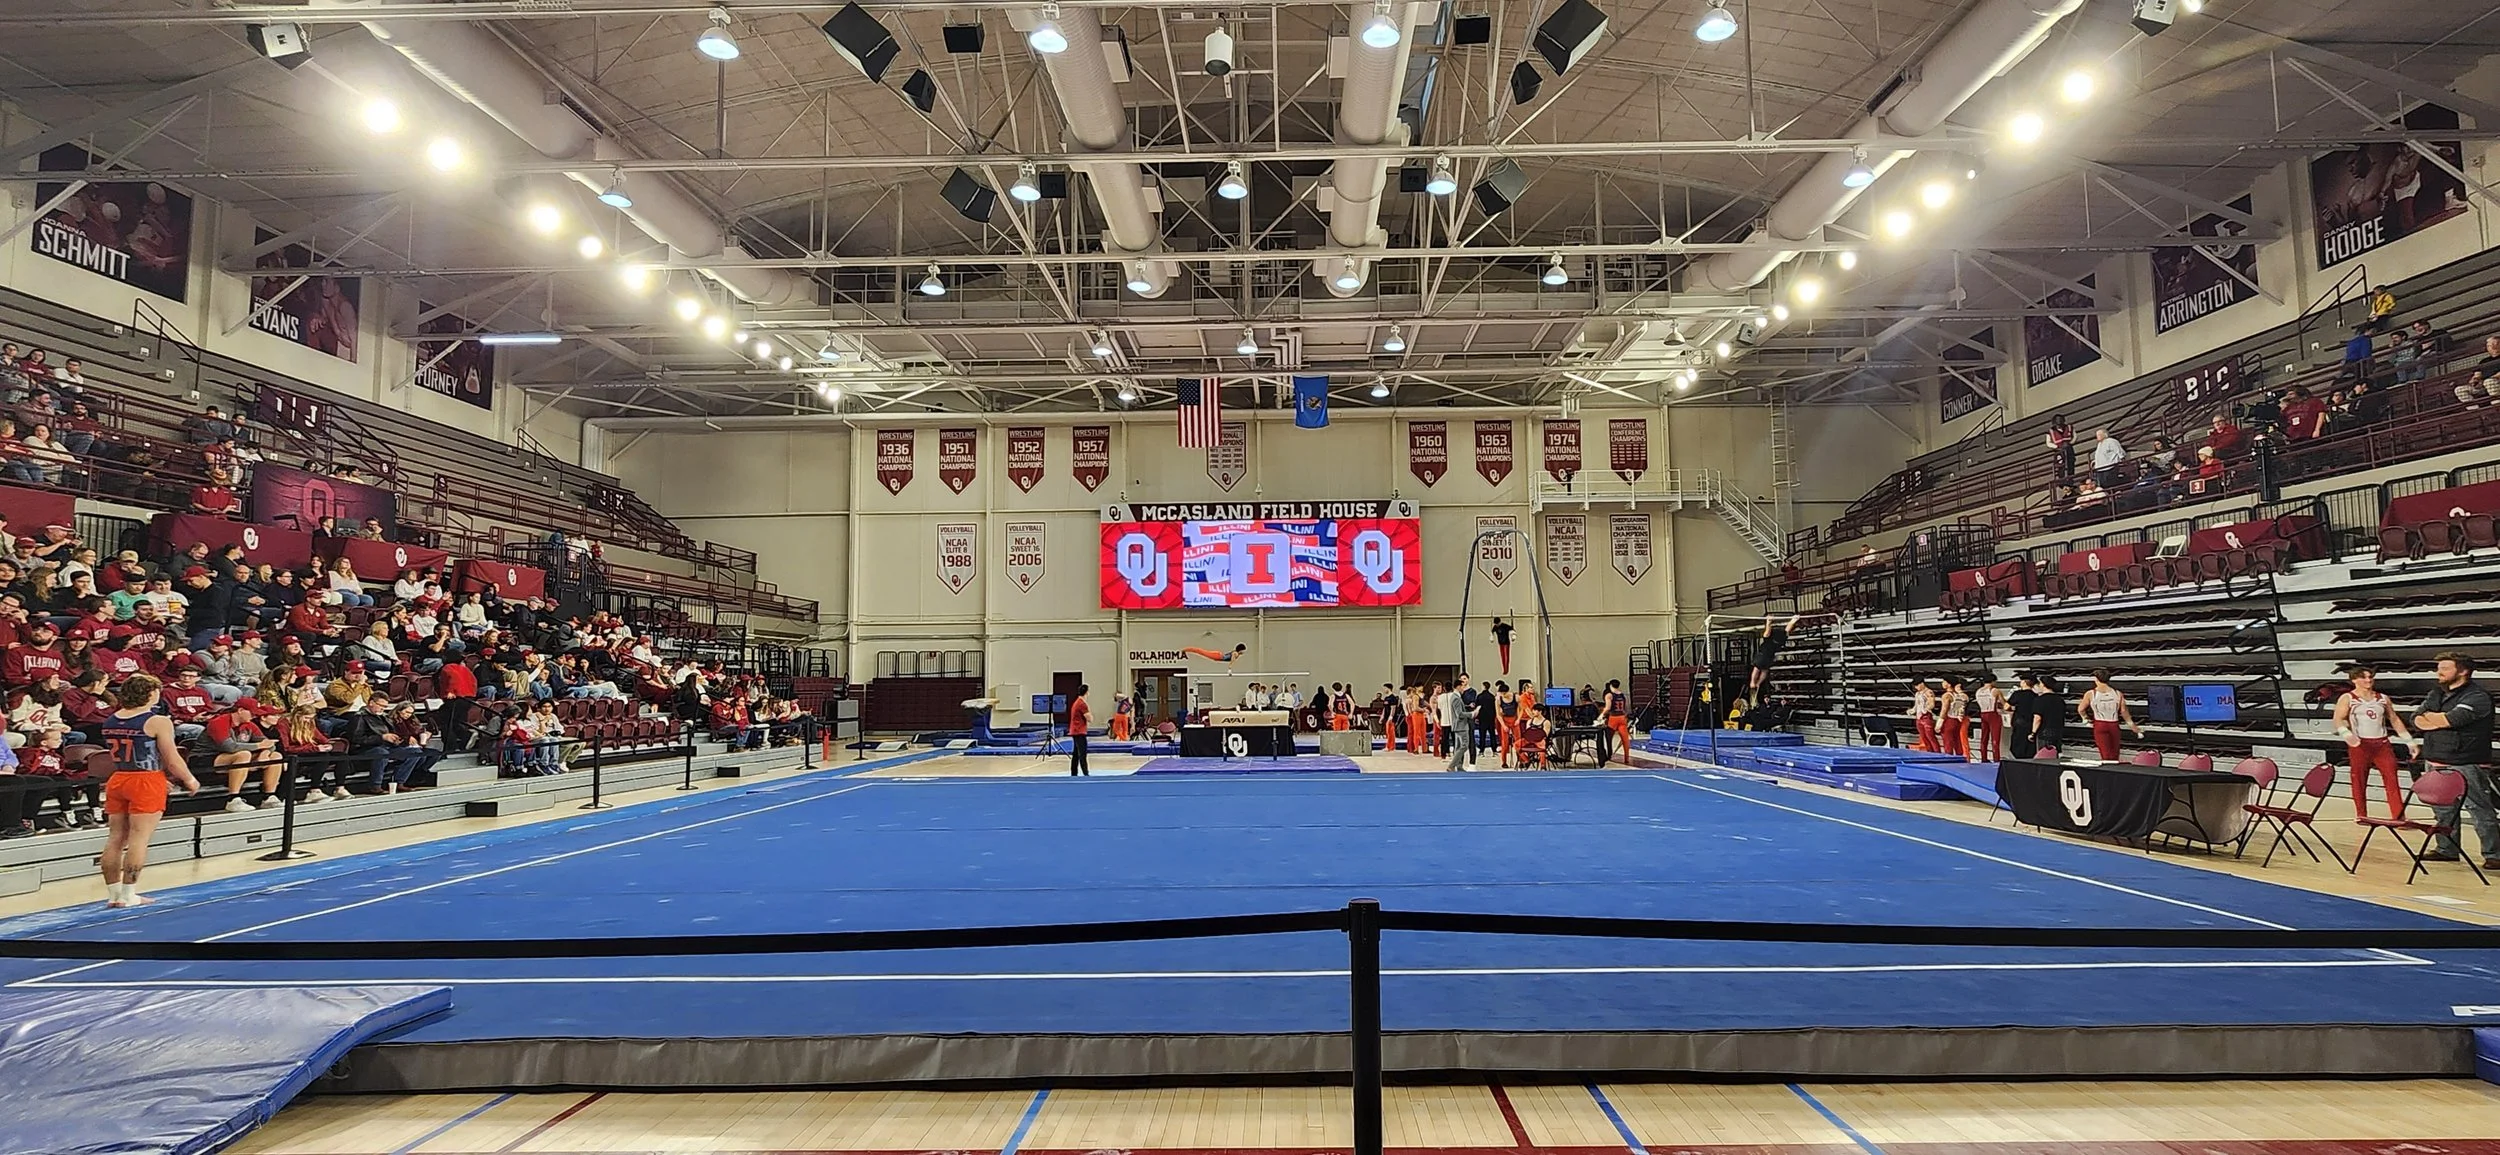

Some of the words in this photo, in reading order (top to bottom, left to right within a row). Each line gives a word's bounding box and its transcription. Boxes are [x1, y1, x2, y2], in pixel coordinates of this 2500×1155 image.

[42, 218, 87, 237] JOANNA
[2324, 221, 2355, 238] DANNY
[2325, 216, 2385, 264] HODGE
[39, 223, 130, 280] SCHMITT
[2160, 279, 2234, 330] ARRINGTON
[2032, 354, 2062, 383] DRAKE
[1944, 393, 1973, 420] CONNER
[941, 431, 975, 439] WRESTLING
[1009, 430, 1043, 438] WRESTLING
[1549, 434, 1575, 445] 1974
[1078, 441, 1104, 451] 1957
[1415, 436, 1442, 447] 1960
[1480, 435, 1507, 446] 1963
[882, 444, 909, 455] 1936
[945, 443, 968, 454] 1951
[1013, 442, 1039, 452] 1952
[1109, 506, 1121, 521] OU
[1260, 504, 1312, 519] FIELD
[1319, 503, 1377, 518] HOUSE
[1399, 502, 1411, 517] OU
[1283, 523, 1314, 534] ILLINI
[1482, 548, 1512, 559] 2010
[942, 555, 971, 567] 1988
[1009, 554, 1041, 566] 2006
[1117, 533, 1168, 597] OU
[1185, 557, 1215, 568] ILLINI
[1246, 543, 1274, 584] I
[1354, 530, 1403, 594] OU
[1292, 566, 1324, 578] ILLINI
[1244, 594, 1277, 603] ILLINI
[1130, 651, 1188, 660] OKLAHOMA
[2186, 697, 2202, 705] OKL
[1307, 715, 1317, 727] OU
[106, 739, 133, 762] 27
[1228, 734, 1248, 757] OU
[2060, 771, 2092, 826] OU
